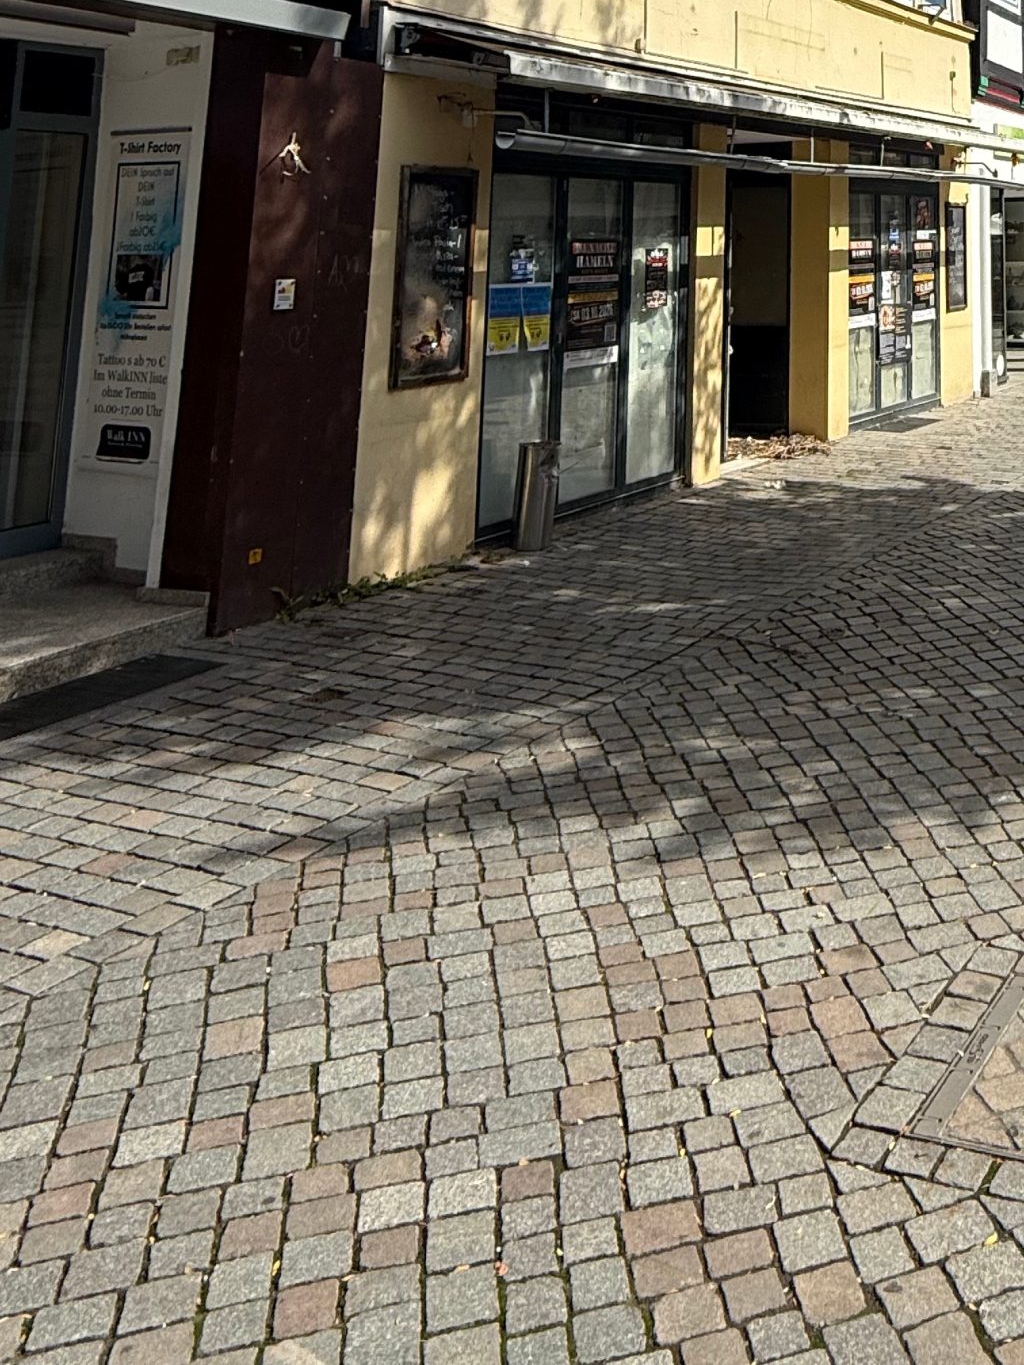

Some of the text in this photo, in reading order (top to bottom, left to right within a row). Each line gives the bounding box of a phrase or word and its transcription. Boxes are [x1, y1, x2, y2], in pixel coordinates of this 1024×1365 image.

[120, 141, 181, 155] T-Shirt Factory
[138, 181, 154, 192] DEIN
[134, 354, 144, 366] ab
[93, 369, 105, 381] Im
[101, 385, 156, 400] ohne Termin
[93, 404, 163, 417] 10.00-17.00 Uhr
